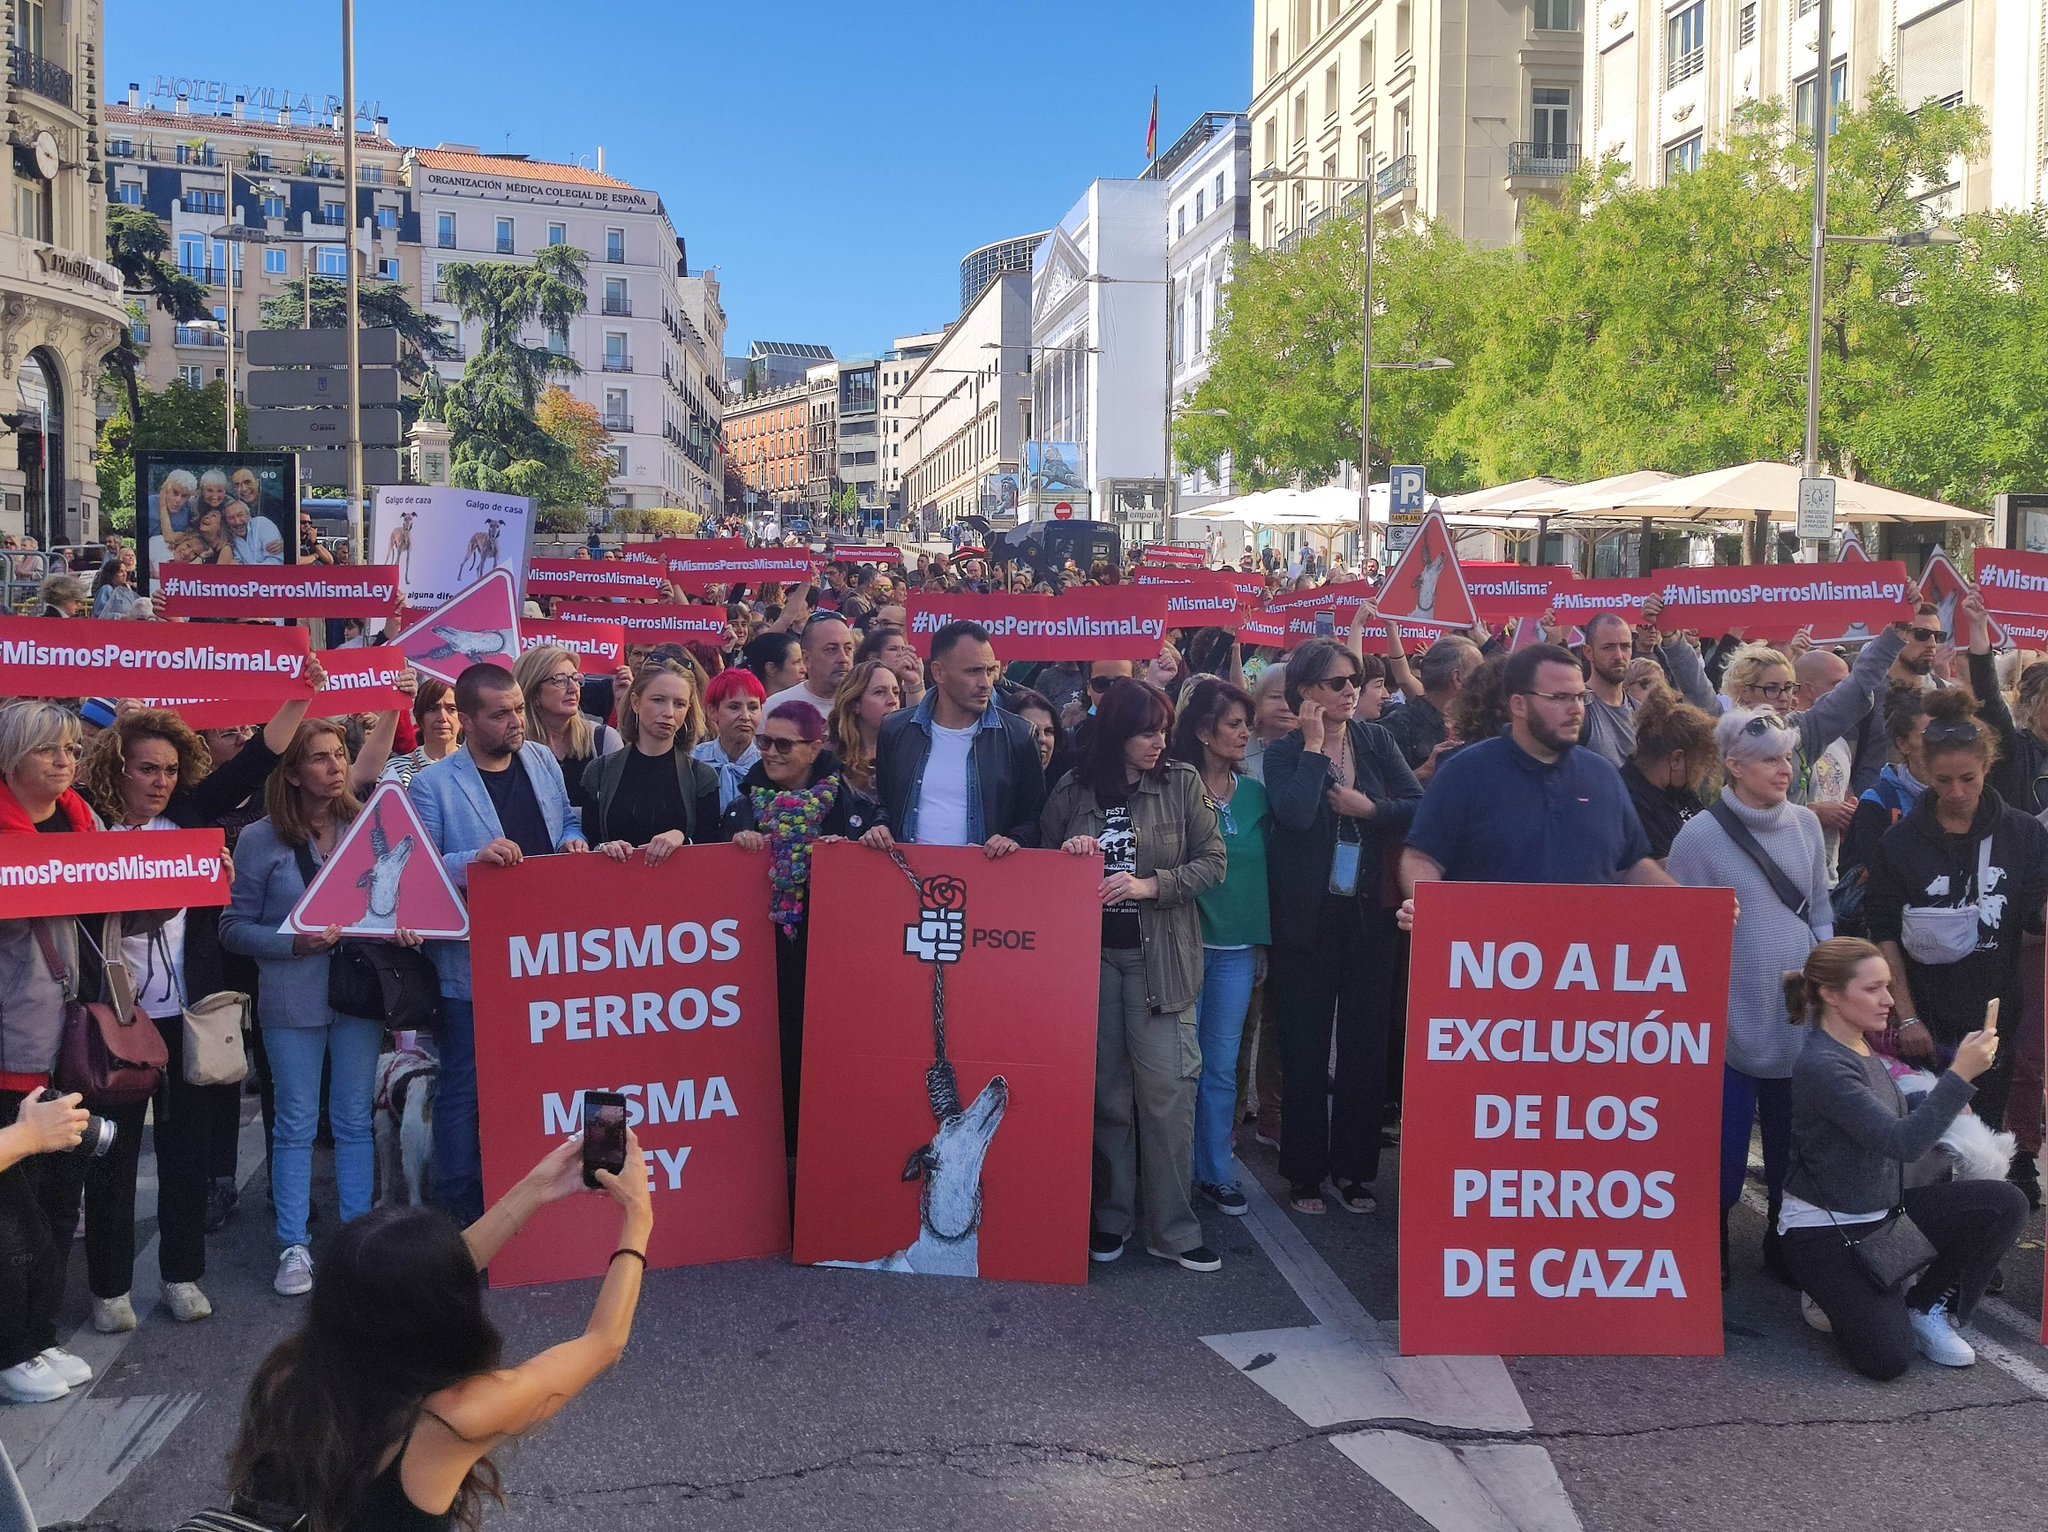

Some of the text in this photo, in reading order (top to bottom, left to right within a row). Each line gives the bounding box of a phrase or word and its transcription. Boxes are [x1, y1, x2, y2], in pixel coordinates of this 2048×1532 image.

[155, 75, 386, 122] HOTEL VILLA RAL
[428, 174, 647, 206] ORGANIZACIÓN MÉDICA COLEGIAL DE ESPAÑA
[385, 496, 432, 505] Galgo de caza
[1400, 473, 1421, 504] P
[466, 500, 523, 515] Galgo de casa
[1129, 511, 1159, 520] empark
[528, 568, 662, 588] MismosPerrosMismaLey
[669, 558, 809, 572] #MismosPerrosMismaLey
[165, 578, 393, 602] #MismosPerrosMismaLey
[407, 592, 434, 601] alguna
[1663, 581, 1904, 605] #MismosPerrosMismaLey
[0, 640, 304, 678] MismosPerrosMismaLey
[0, 854, 221, 887] mosPerrosMismaLey
[509, 919, 741, 977] MISMOS
[972, 928, 1036, 951] PSOE
[1449, 941, 1687, 992] NO A LA
[528, 985, 742, 1043] PERROS
[1427, 1010, 1711, 1064] EXCLUSIÓN
[542, 1076, 739, 1135] MSMA
[1474, 1094, 1659, 1141] DE LOS
[1453, 1169, 1676, 1219] PERROS
[1444, 1248, 1687, 1298] DE CAZA
